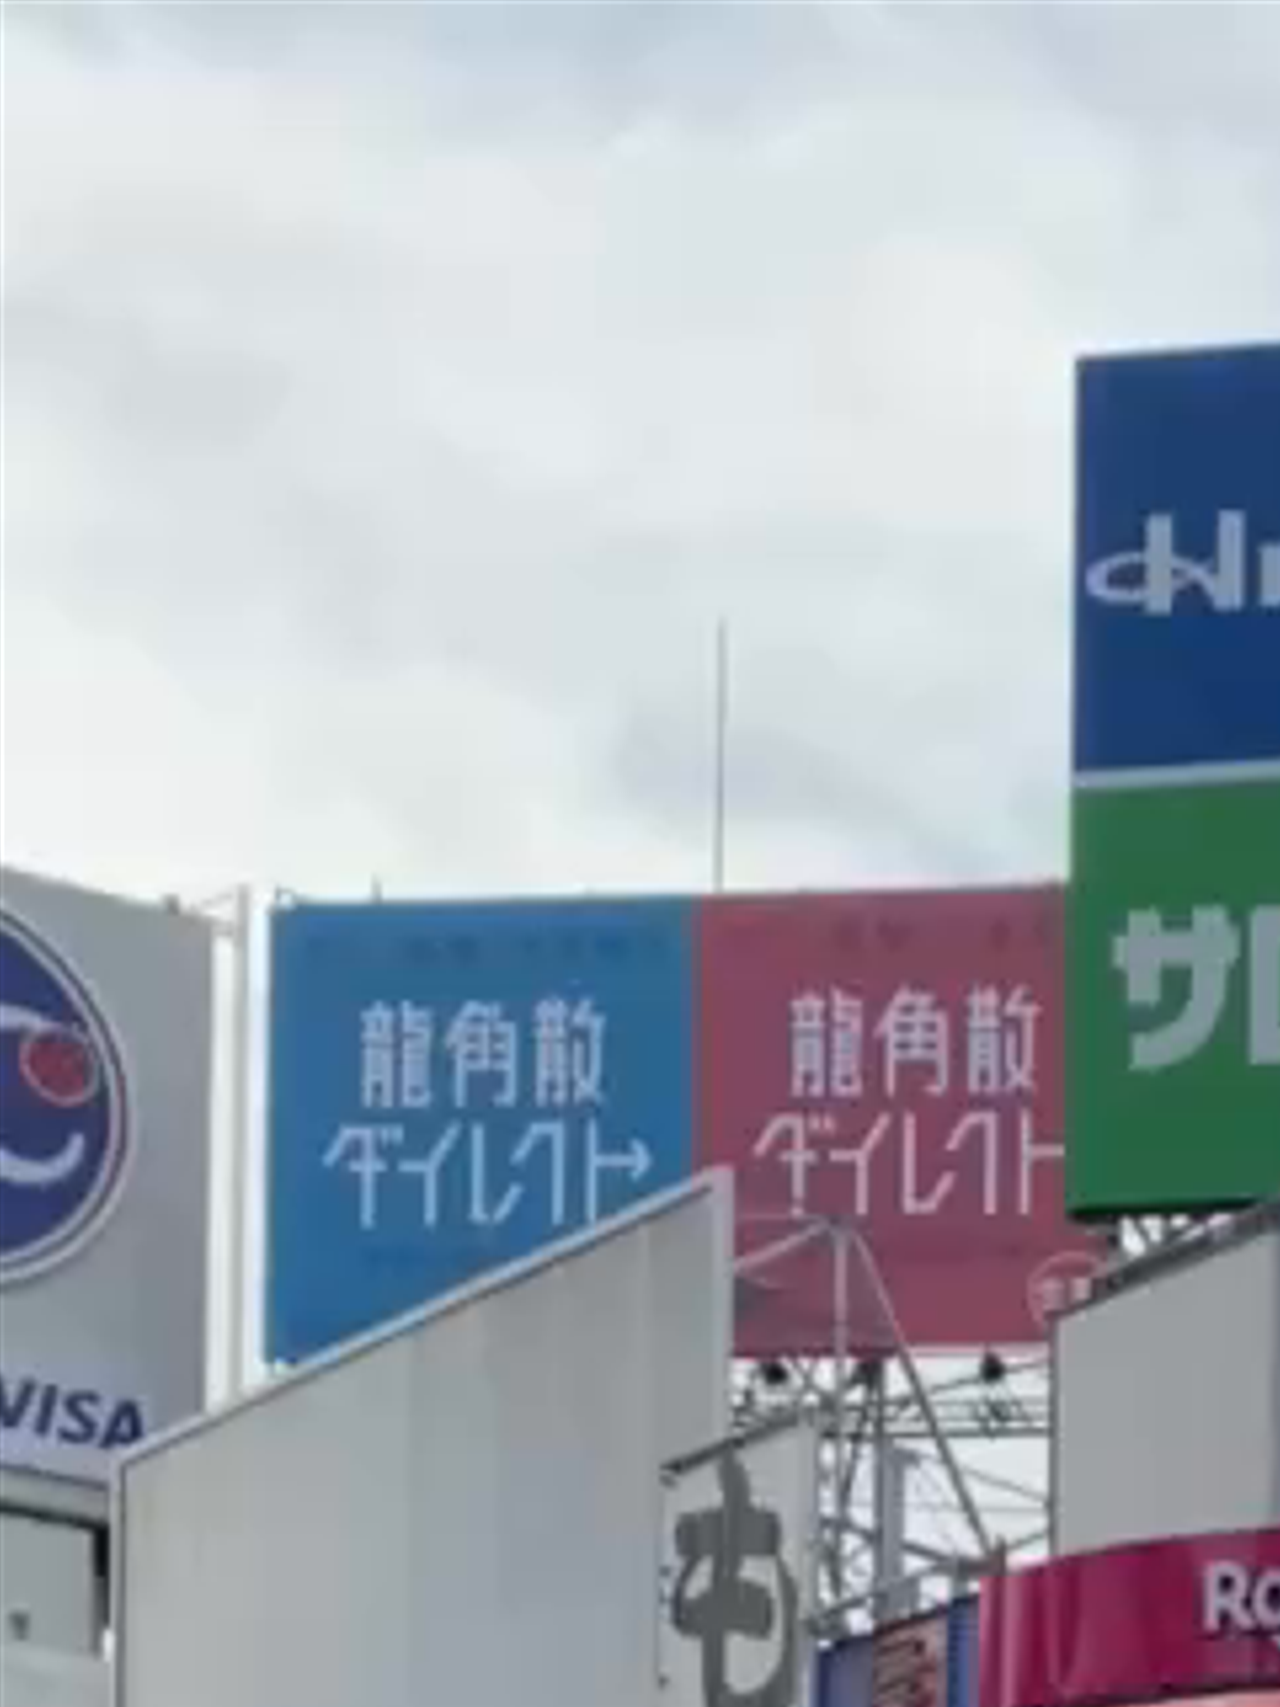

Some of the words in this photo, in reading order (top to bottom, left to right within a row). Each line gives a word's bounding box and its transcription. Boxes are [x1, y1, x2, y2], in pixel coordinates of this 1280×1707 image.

[359, 998, 607, 1110] 龍角散
[788, 983, 1042, 1100] 龍角散
[322, 1117, 650, 1230] ダイレクト
[753, 1110, 1066, 1220] ダイレクト
[0, 1373, 144, 1449] VISA
